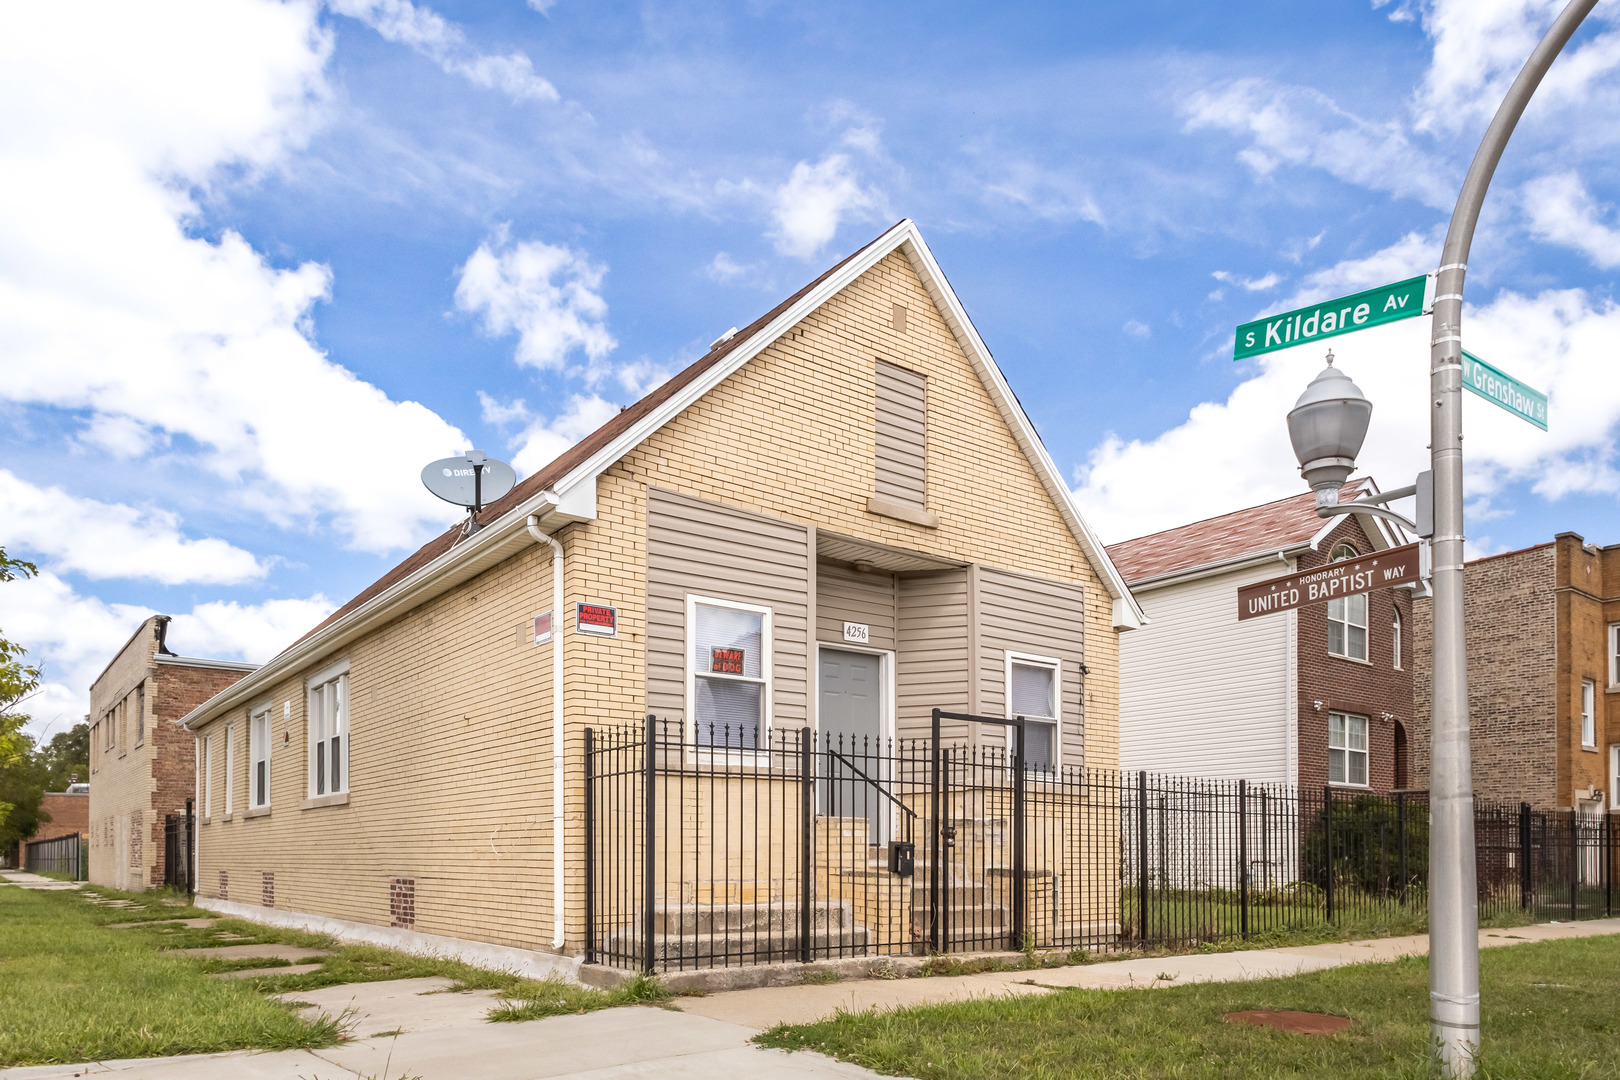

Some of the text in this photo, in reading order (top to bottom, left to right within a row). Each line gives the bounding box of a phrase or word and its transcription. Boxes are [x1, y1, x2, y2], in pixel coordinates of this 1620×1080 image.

[1245, 294, 1410, 348] S Kildare Av
[1463, 360, 1545, 420] W Grenshaw St
[453, 466, 491, 477] DIRETV
[1299, 567, 1345, 585] HONORARY
[1249, 565, 1406, 614] UNITED BAPTIST WAY
[579, 611, 614, 623] PROPERTY
[582, 605, 610, 616] PRIVATE
[846, 625, 866, 640] 4256
[714, 648, 742, 660] BEWARE
[722, 662, 742, 673] DOG
